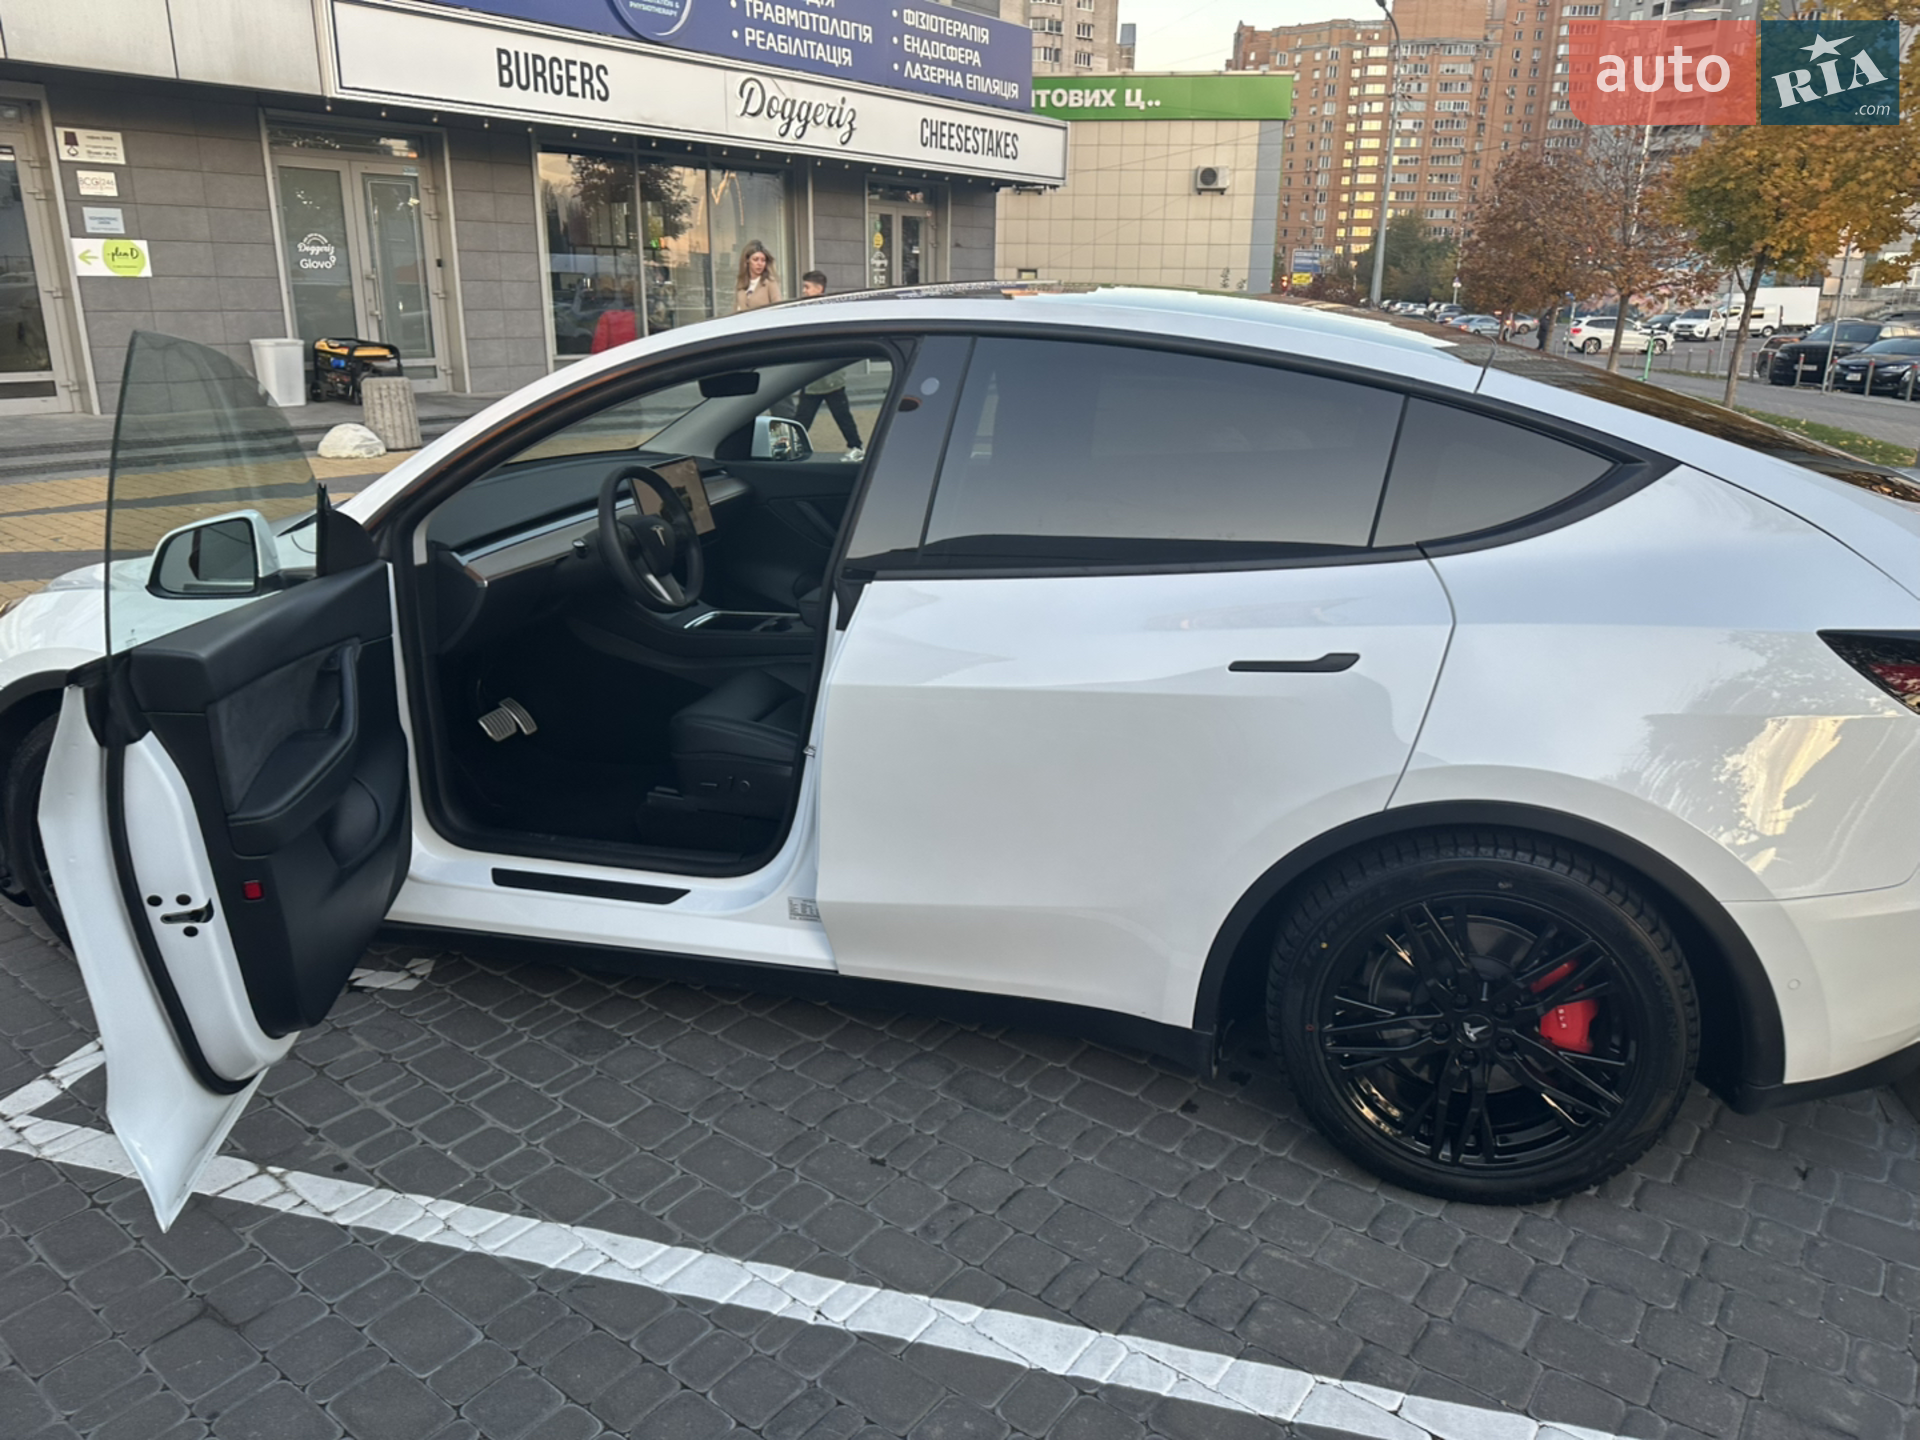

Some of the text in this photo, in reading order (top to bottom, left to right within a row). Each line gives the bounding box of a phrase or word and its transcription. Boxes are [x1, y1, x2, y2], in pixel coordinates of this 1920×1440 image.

[745, 0, 873, 44] ТРАВМОТОЛОГІЯ
[903, 9, 990, 45] ФІЗІОТЕРАПІЯ
[745, 27, 853, 67] РЕАБІЛІТАЦІЯ
[903, 35, 982, 68] ЕНДОСФЕРА
[496, 47, 610, 102] BURGERS
[904, 61, 1019, 100] ЛАЗЕРНА ЕПІЛЯЦІЯ
[737, 77, 858, 146] Doggeriz
[919, 117, 1020, 161] CHEESESTAKES
[299, 257, 334, 269] Glovo
